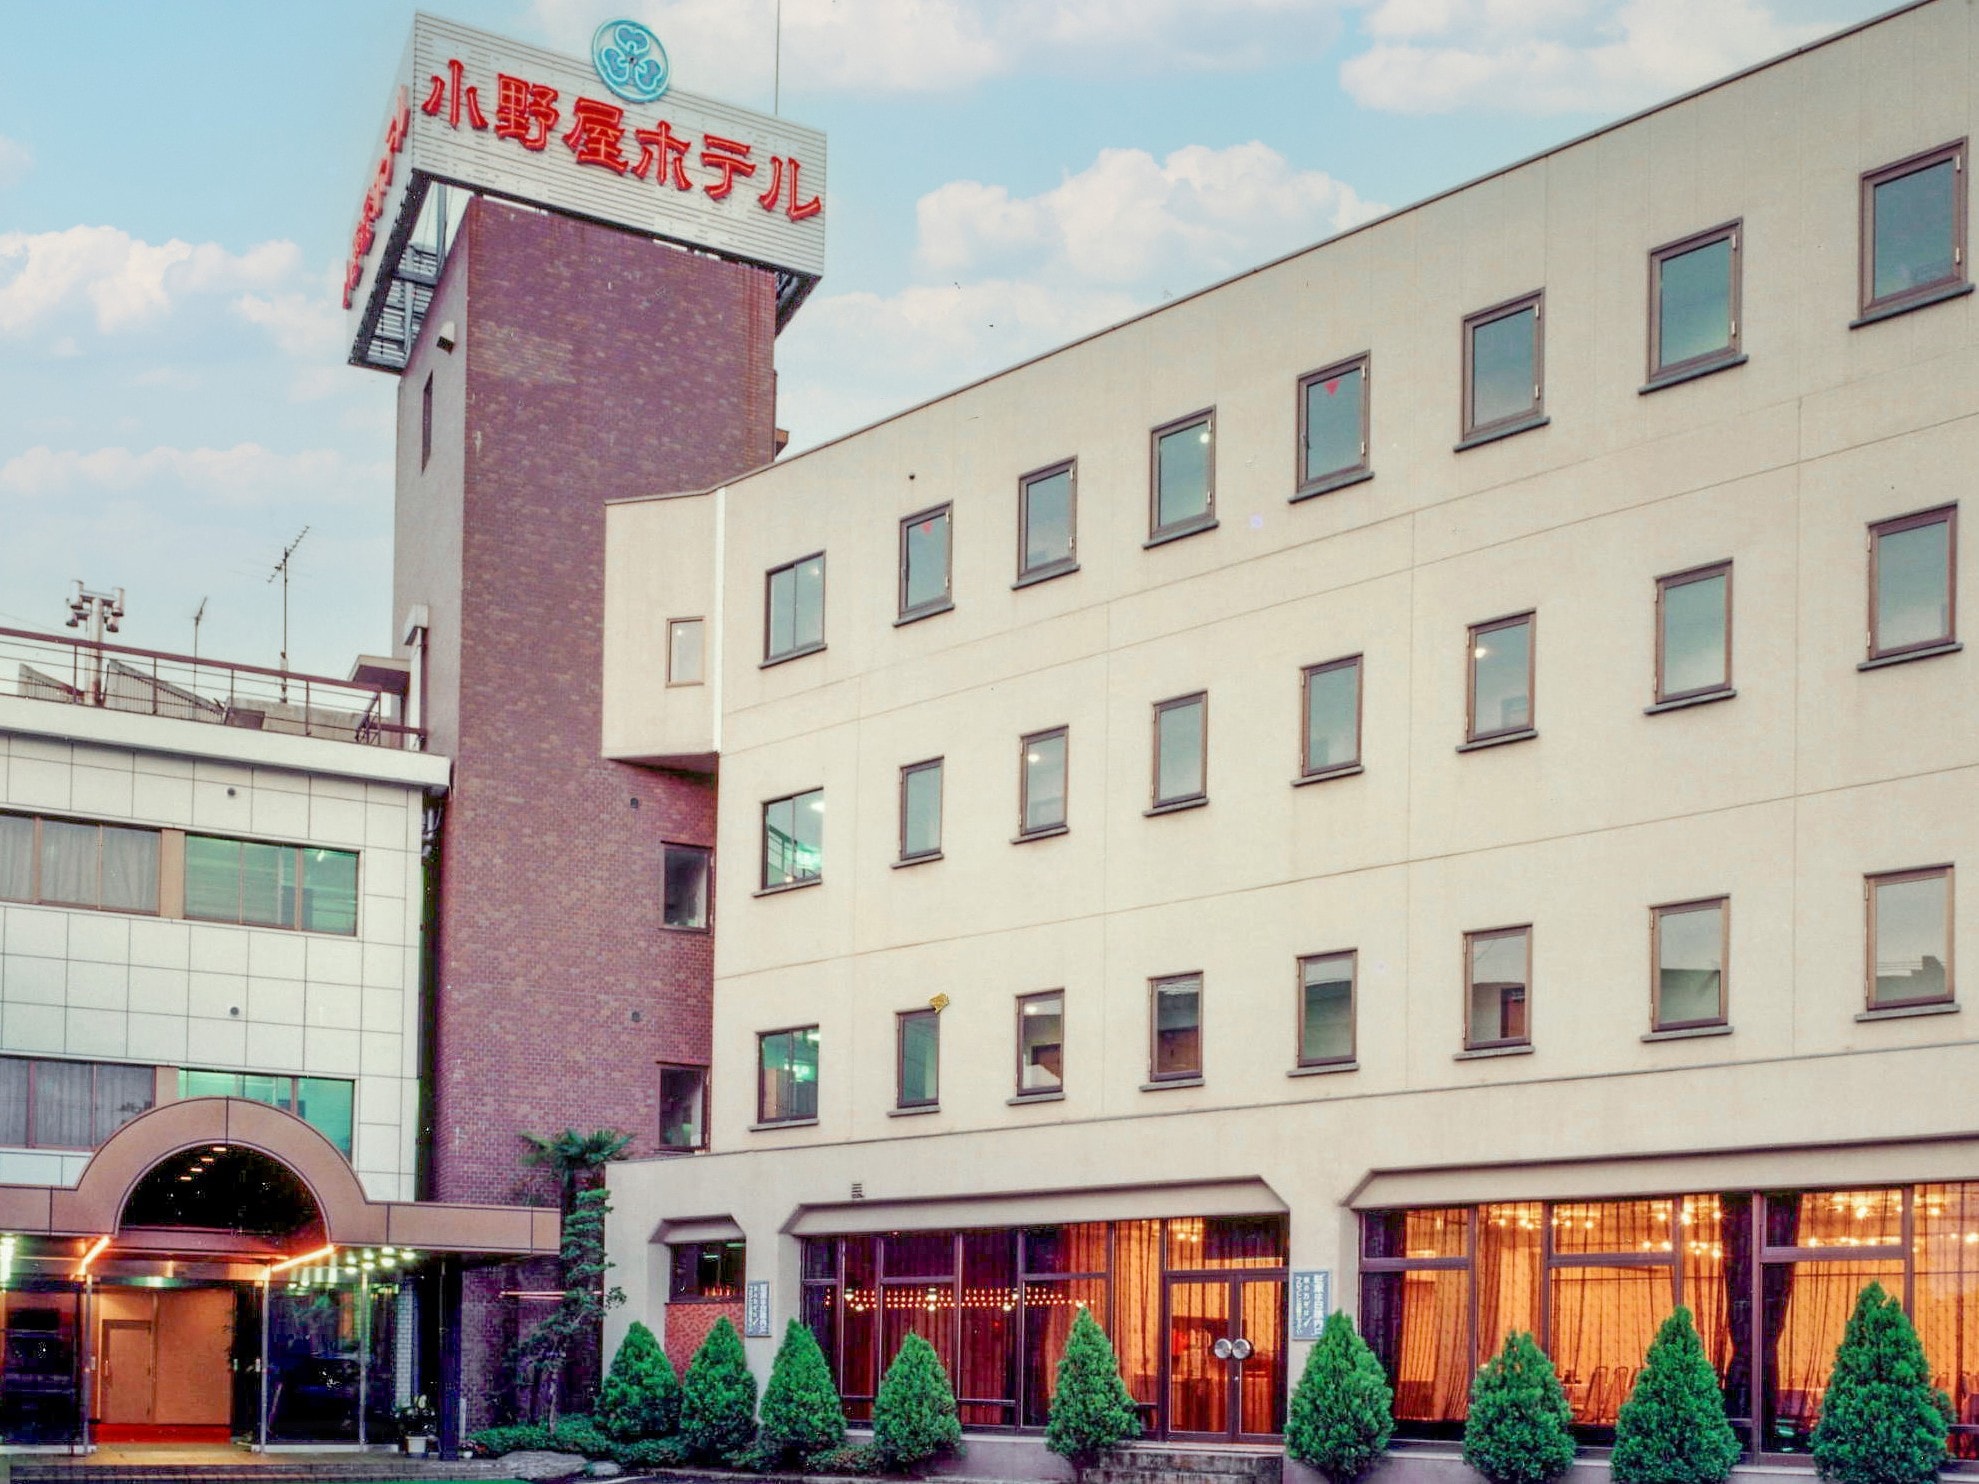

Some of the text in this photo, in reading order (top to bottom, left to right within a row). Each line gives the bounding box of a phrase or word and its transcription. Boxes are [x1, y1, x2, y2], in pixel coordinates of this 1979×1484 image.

[421, 58, 822, 223] 小野屋ホテル
